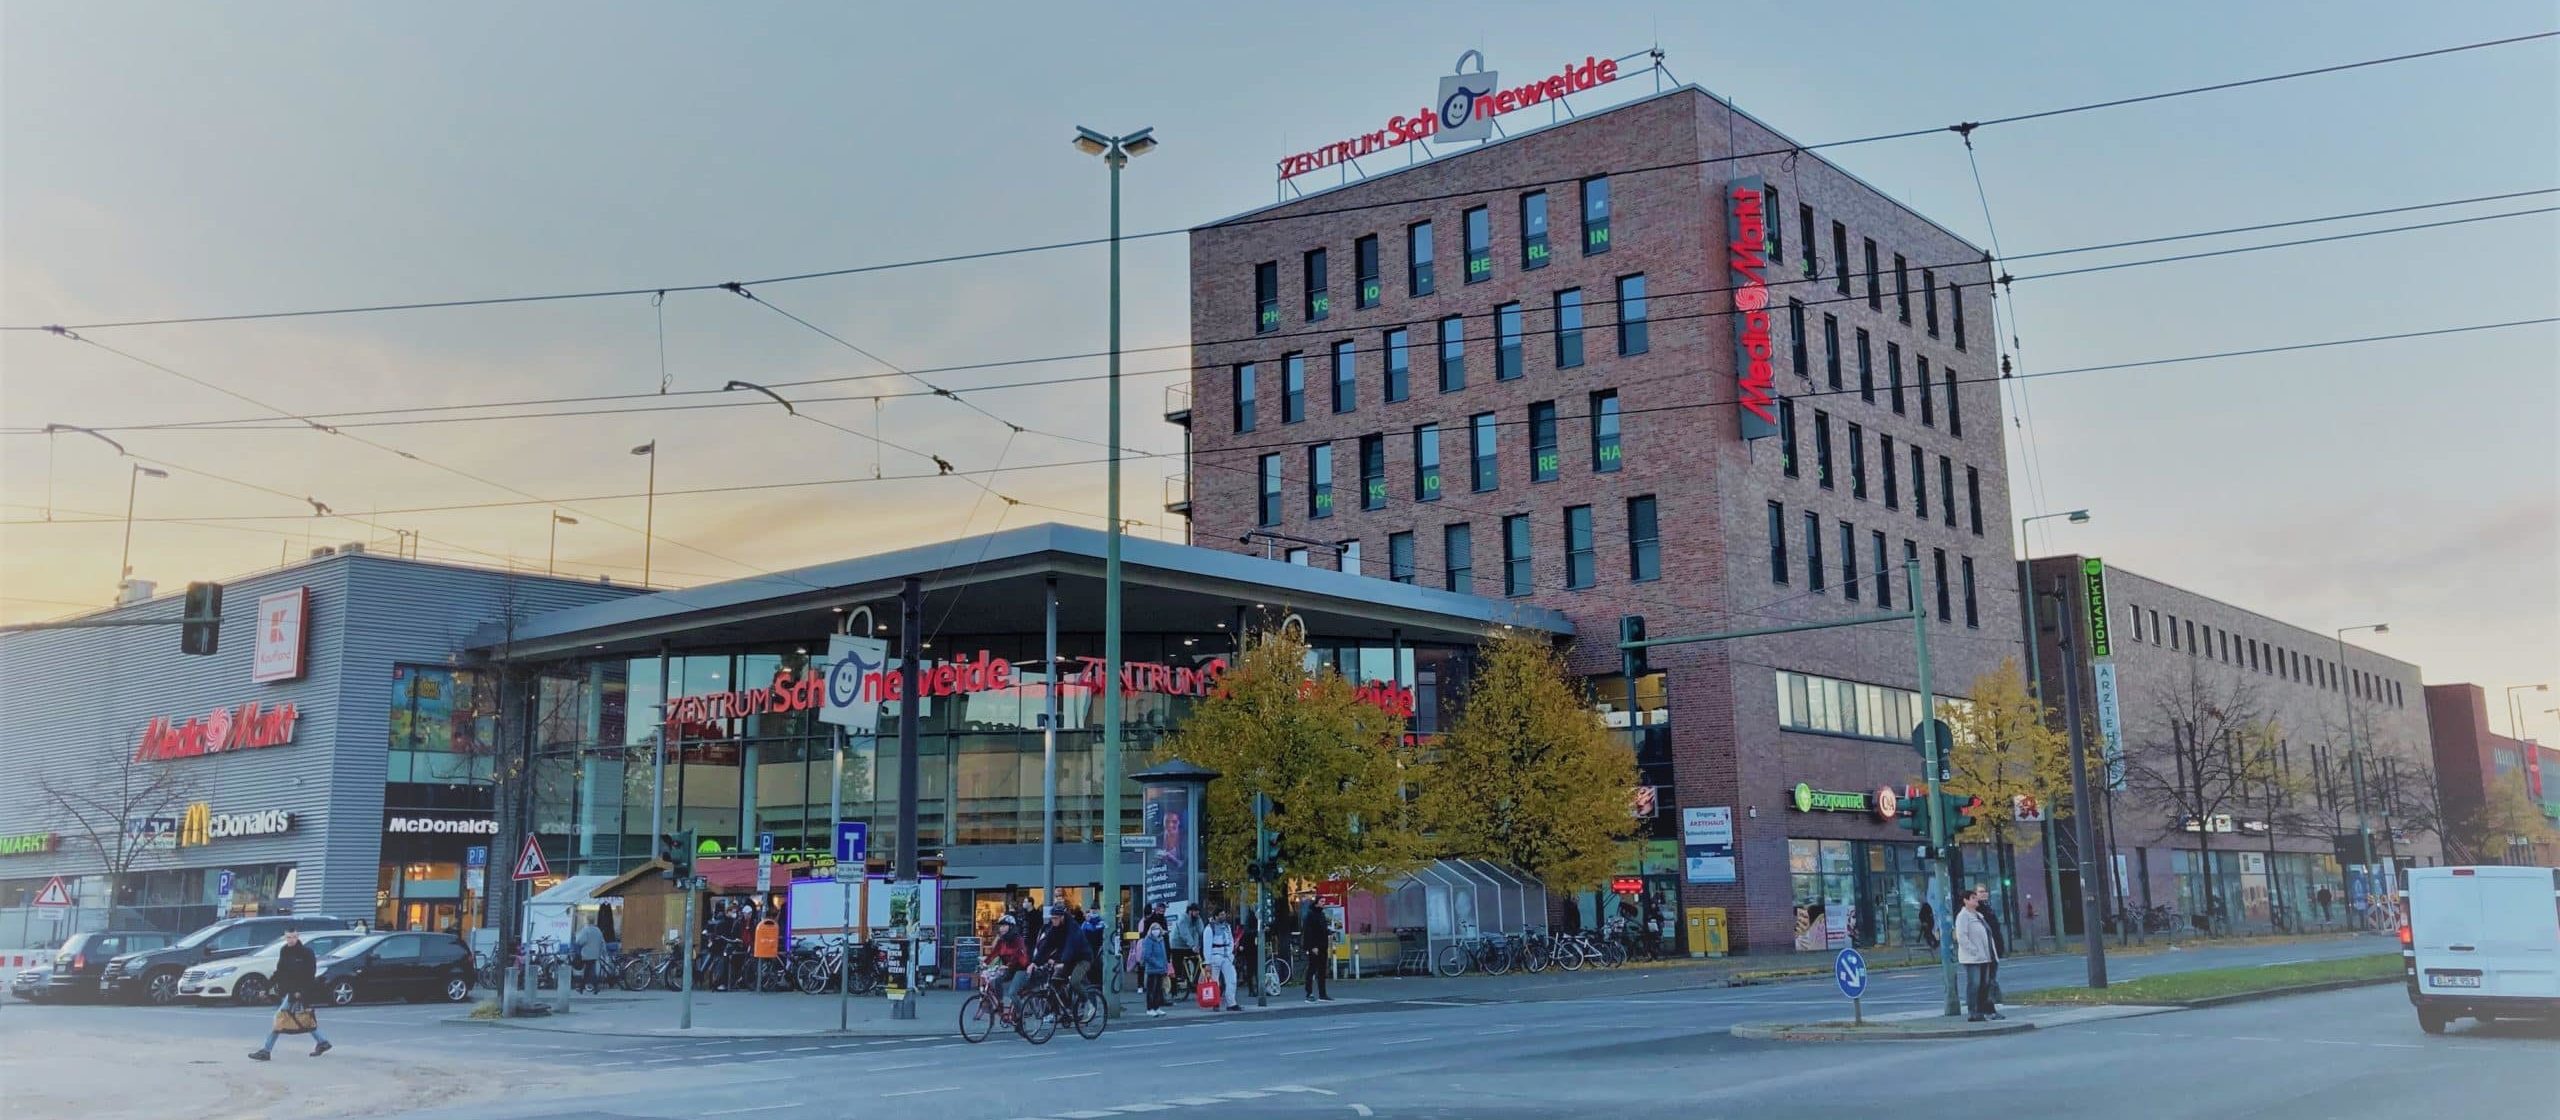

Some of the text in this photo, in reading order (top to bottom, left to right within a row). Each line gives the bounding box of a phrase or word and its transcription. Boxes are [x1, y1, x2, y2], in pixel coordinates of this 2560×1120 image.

[1280, 129, 1385, 181] ZENTRUM
[1470, 258, 1490, 274] BE
[1528, 245, 1549, 260] RL
[1590, 228, 1609, 245] IN
[1730, 184, 1777, 426] Media Markt
[1539, 455, 1558, 471] RE
[1599, 445, 1621, 461] HA
[2089, 576, 2107, 655] BIOMARKT
[664, 690, 773, 725] ZENTRUM
[134, 701, 300, 764] Media Markt
[182, 801, 288, 848] McDonald's
[389, 817, 499, 834] McDonald's
